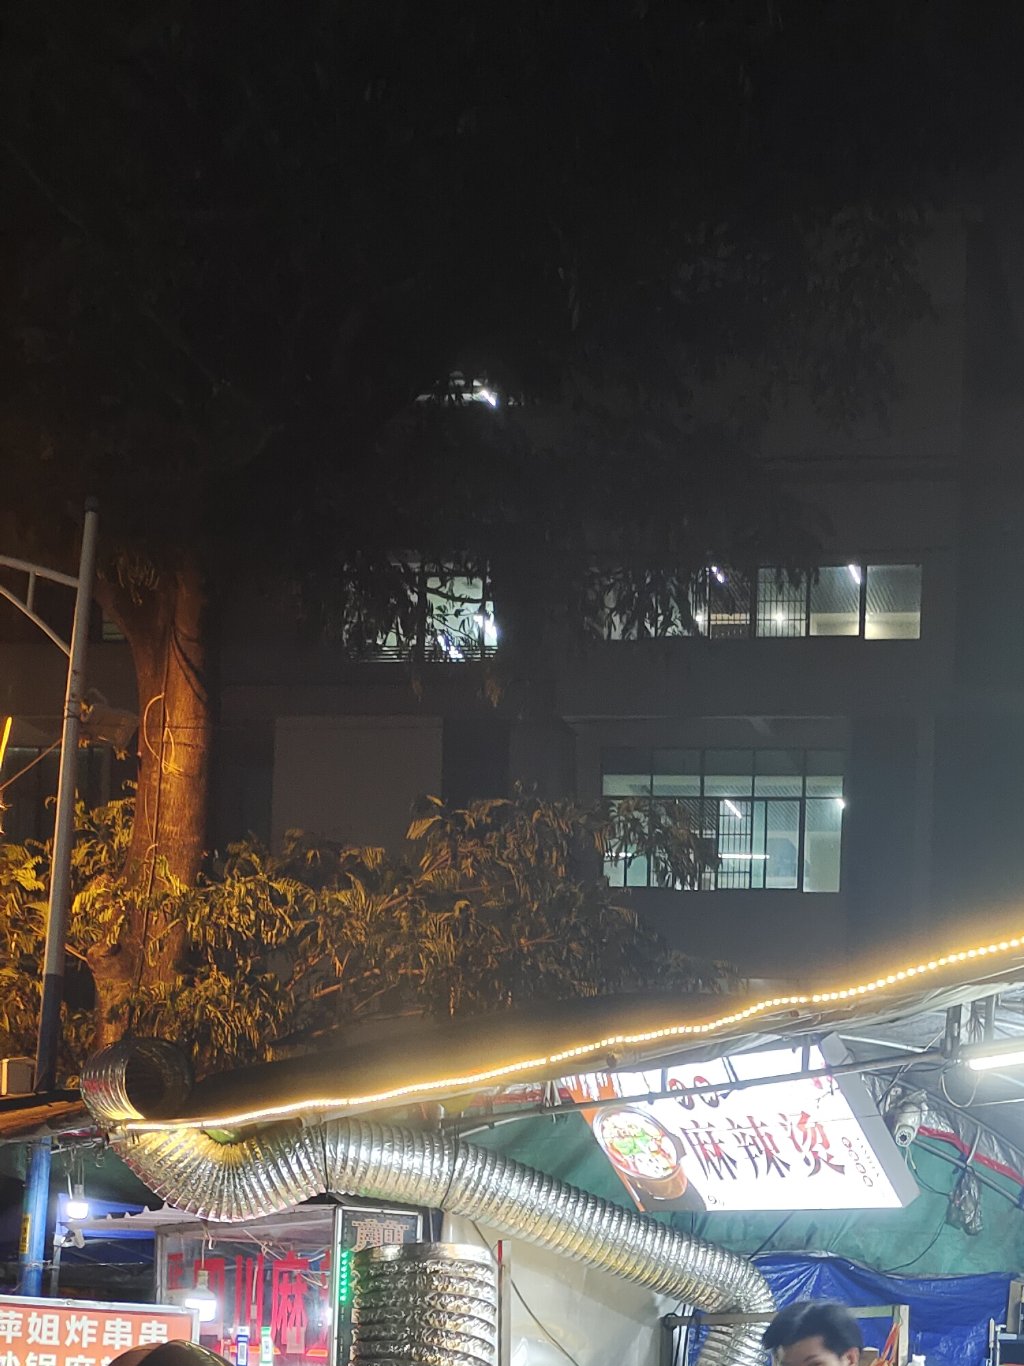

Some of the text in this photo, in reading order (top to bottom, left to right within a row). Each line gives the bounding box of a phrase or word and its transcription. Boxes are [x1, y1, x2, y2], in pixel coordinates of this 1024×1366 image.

[679, 1110, 846, 1181] 麻辣烫
[194, 1249, 331, 1347] 四川麻
